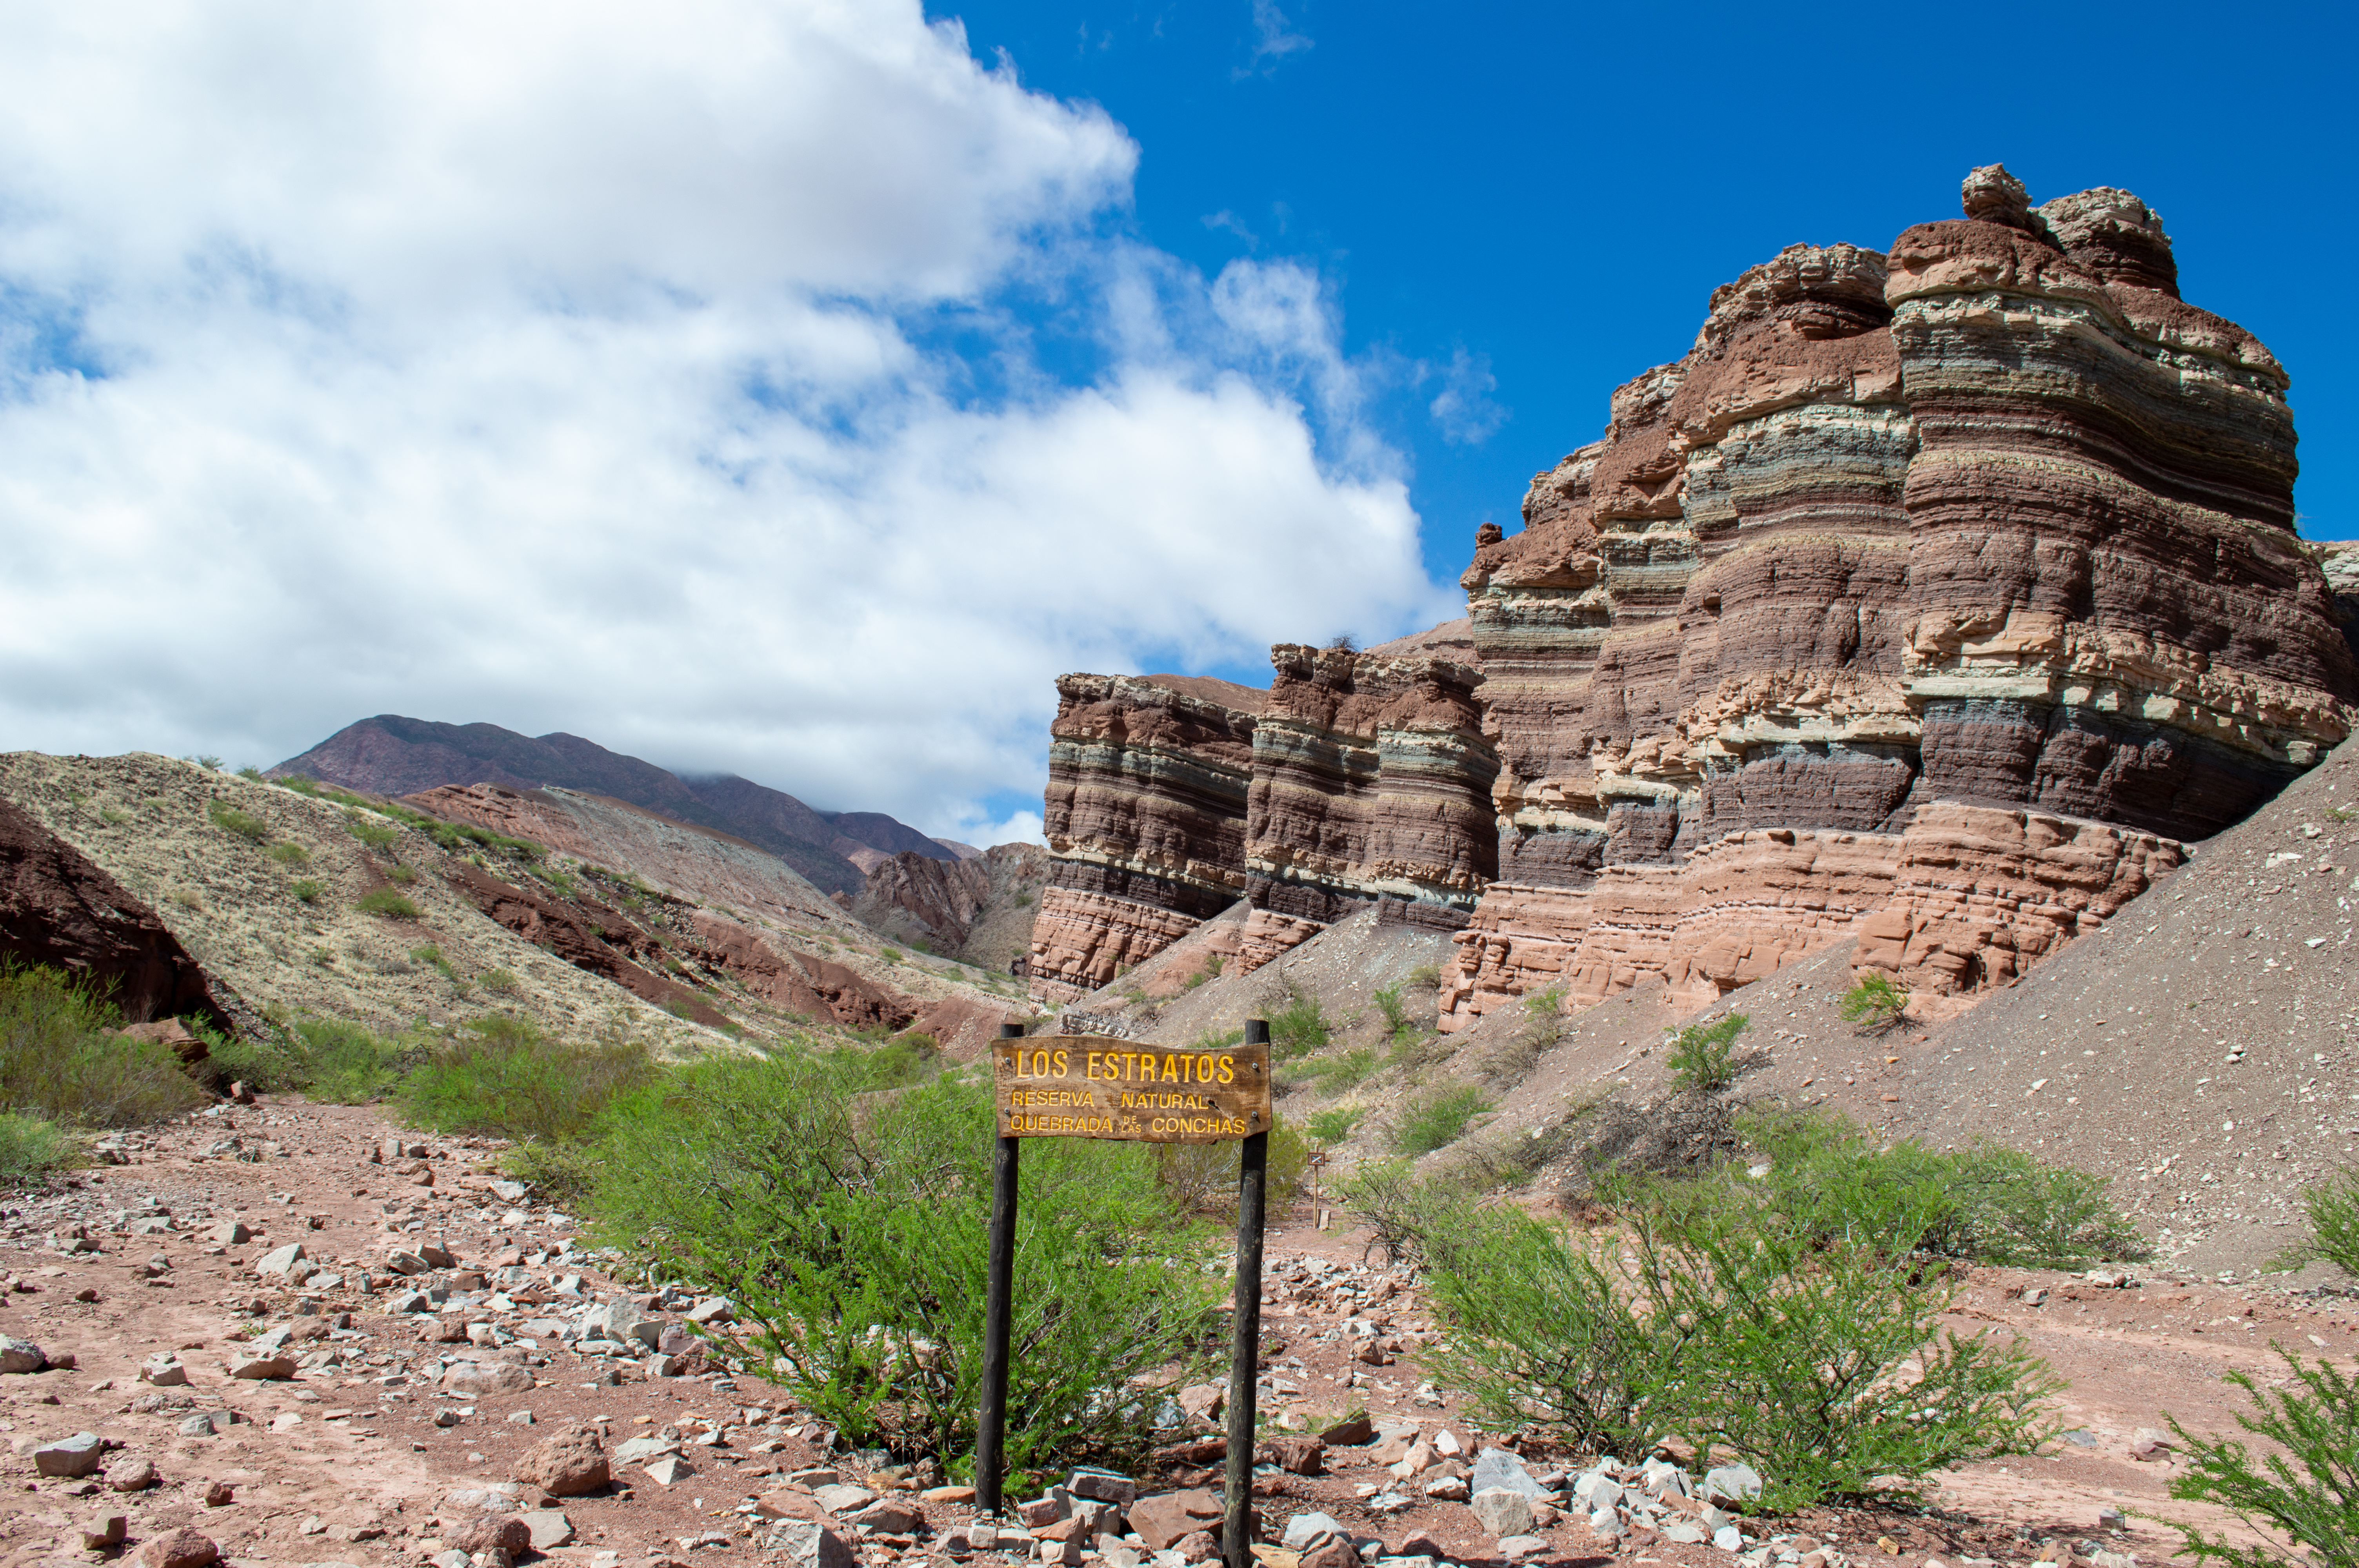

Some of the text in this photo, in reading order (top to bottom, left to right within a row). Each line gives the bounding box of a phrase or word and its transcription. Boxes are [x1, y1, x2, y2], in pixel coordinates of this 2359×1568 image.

[1016, 1048, 1234, 1084] LOS ESTRATOS
[1012, 1090, 1209, 1110] RESERVA NATURAL
[1010, 1114, 1245, 1134] QUEBRADA DE LAS CONCHAS
